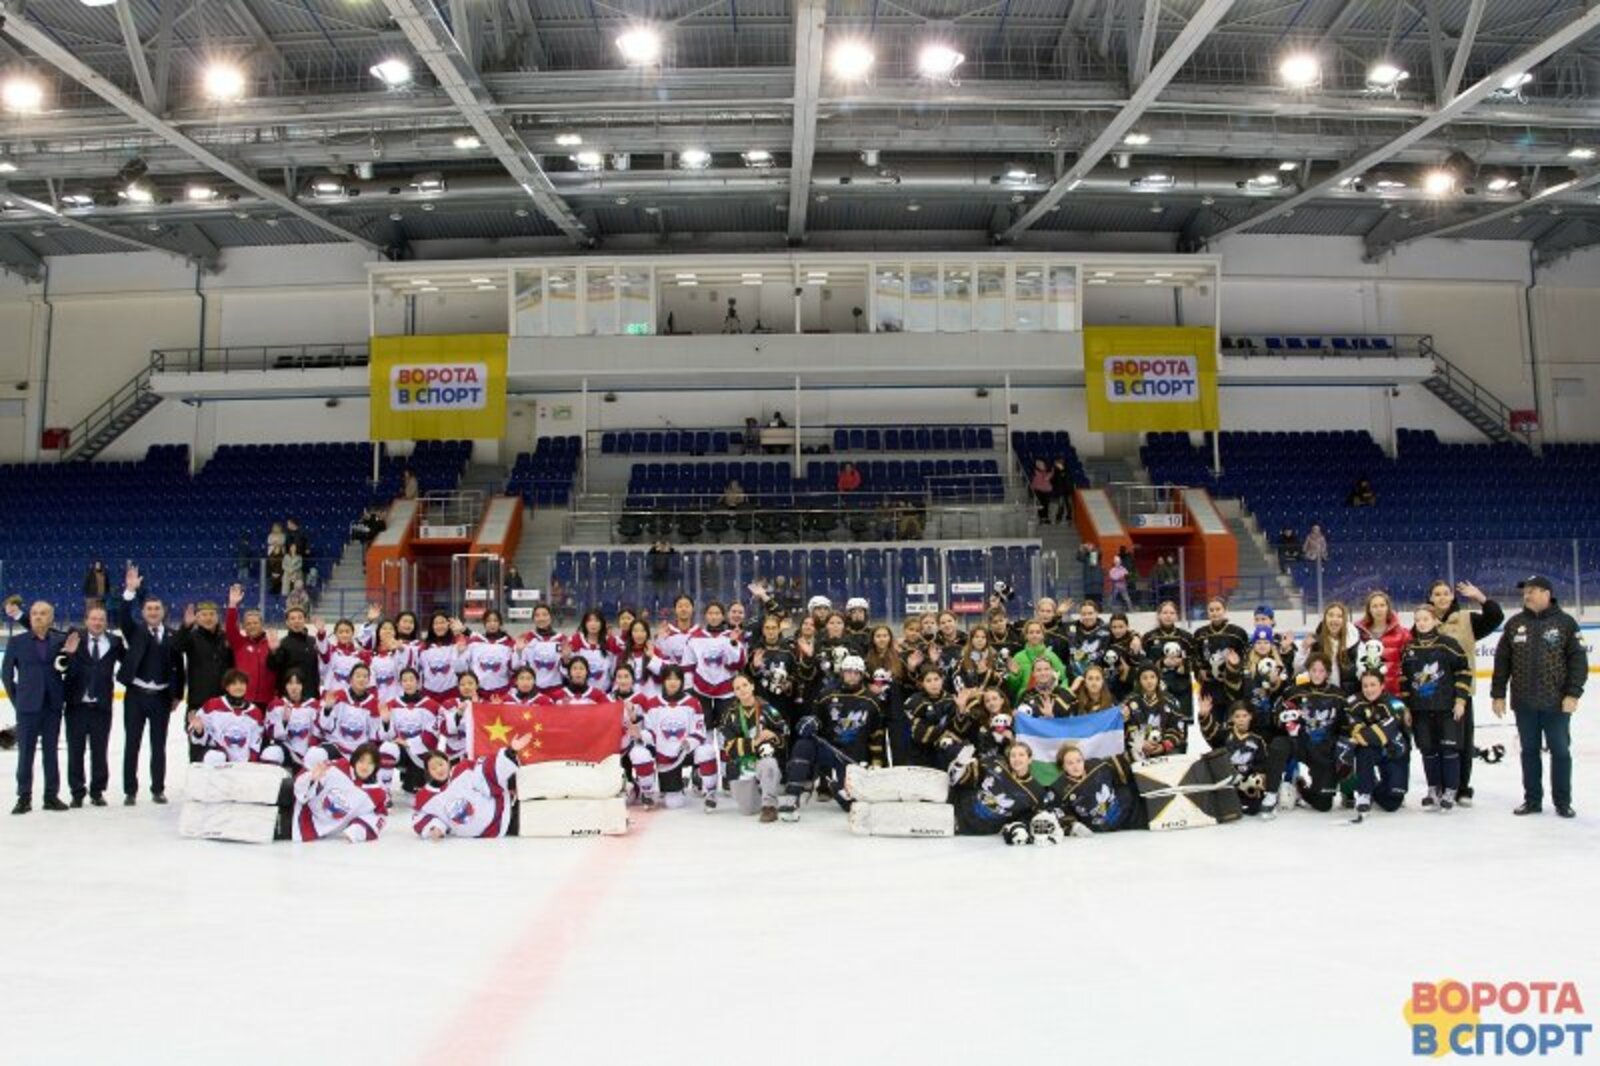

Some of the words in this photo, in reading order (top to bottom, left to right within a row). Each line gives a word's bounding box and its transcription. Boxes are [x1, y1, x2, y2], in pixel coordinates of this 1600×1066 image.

[399, 367, 477, 384] ВОРОТА
[1112, 360, 1190, 376] ВОРОТА
[398, 388, 410, 404] В
[416, 387, 482, 404] СПОРТ
[1113, 380, 1126, 396] В
[1131, 379, 1195, 396] СПОРТ
[1168, 515, 1181, 526] 10
